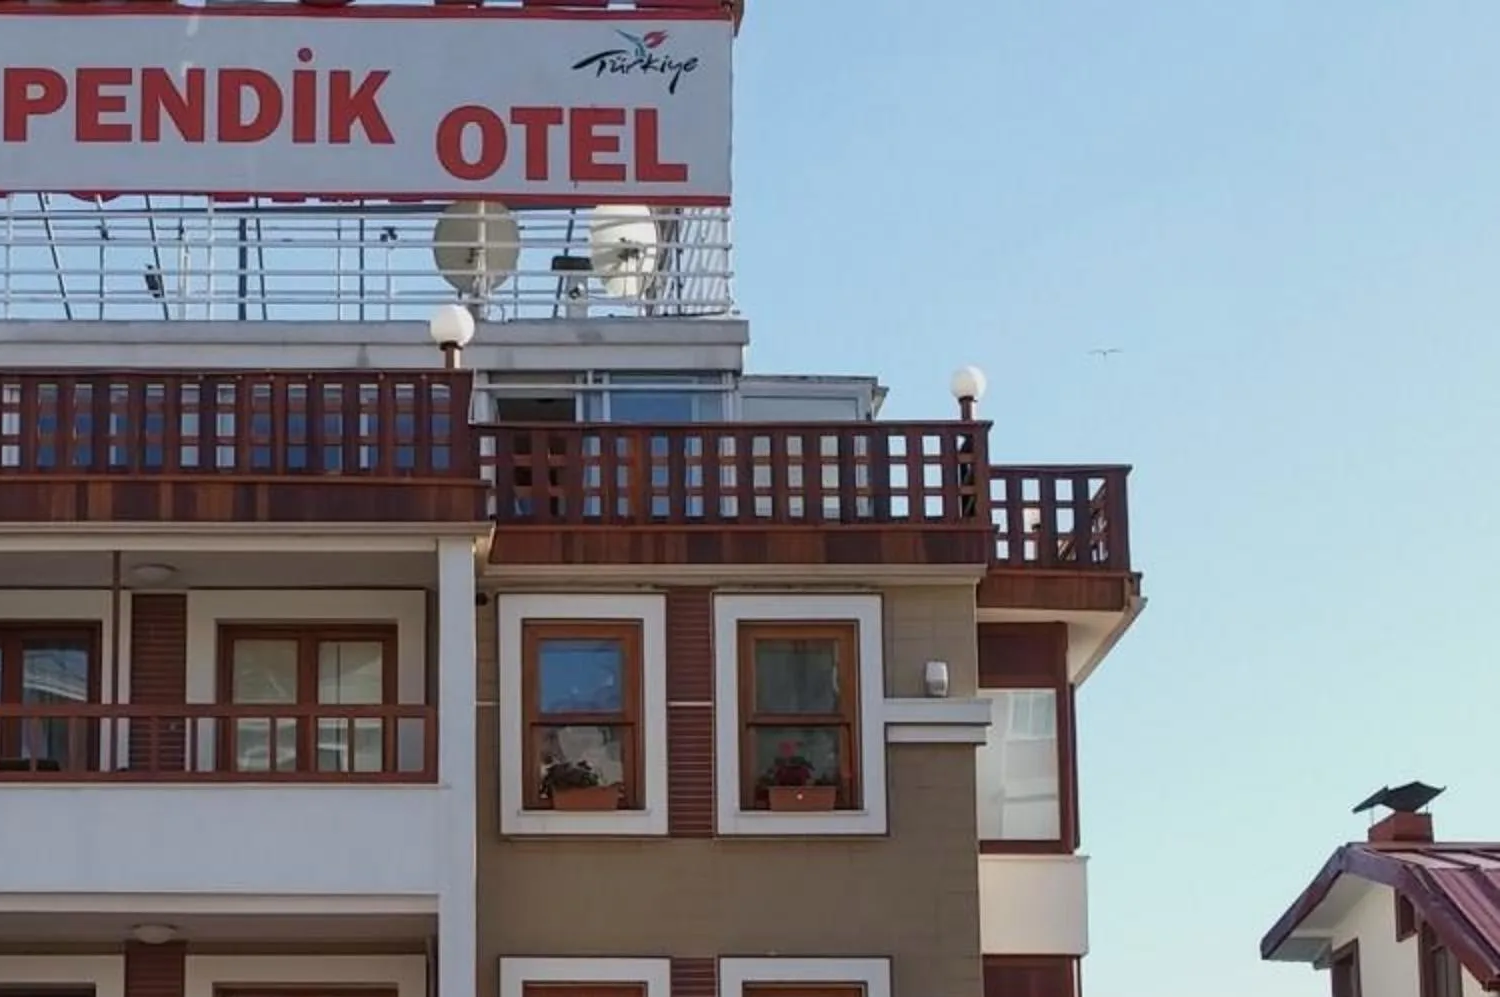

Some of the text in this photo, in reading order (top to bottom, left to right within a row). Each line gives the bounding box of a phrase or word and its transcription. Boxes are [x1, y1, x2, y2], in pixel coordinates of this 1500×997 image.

[2, 47, 396, 145] PENDİK
[436, 105, 689, 183] OTEL
[571, 49, 699, 95] Türkiye
